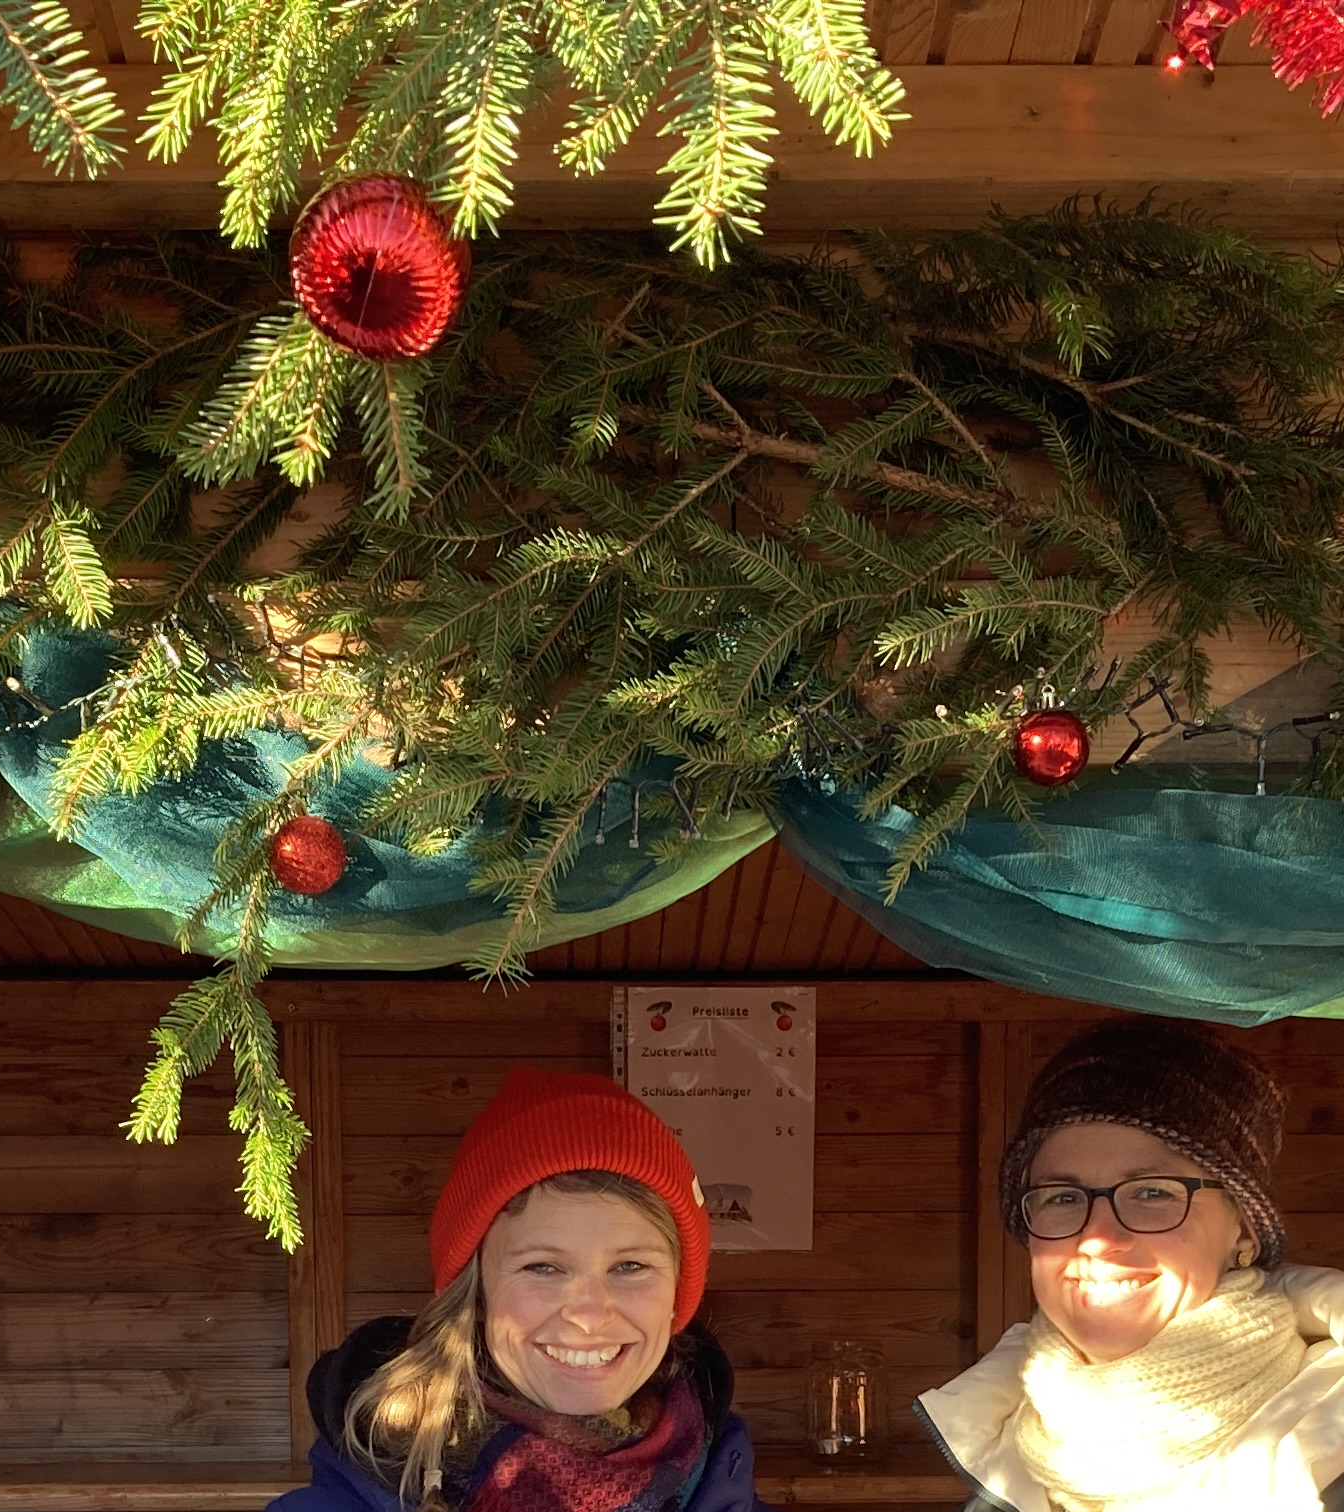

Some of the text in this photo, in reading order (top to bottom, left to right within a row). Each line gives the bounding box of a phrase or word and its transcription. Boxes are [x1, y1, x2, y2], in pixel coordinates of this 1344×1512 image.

[692, 1006, 749, 1017] Preisliste
[641, 1047, 795, 1057] Zuckerwatte 2 €
[641, 1086, 796, 1099] Schlüsselanhänger 8 €
[775, 1126, 795, 1136] 5 €
